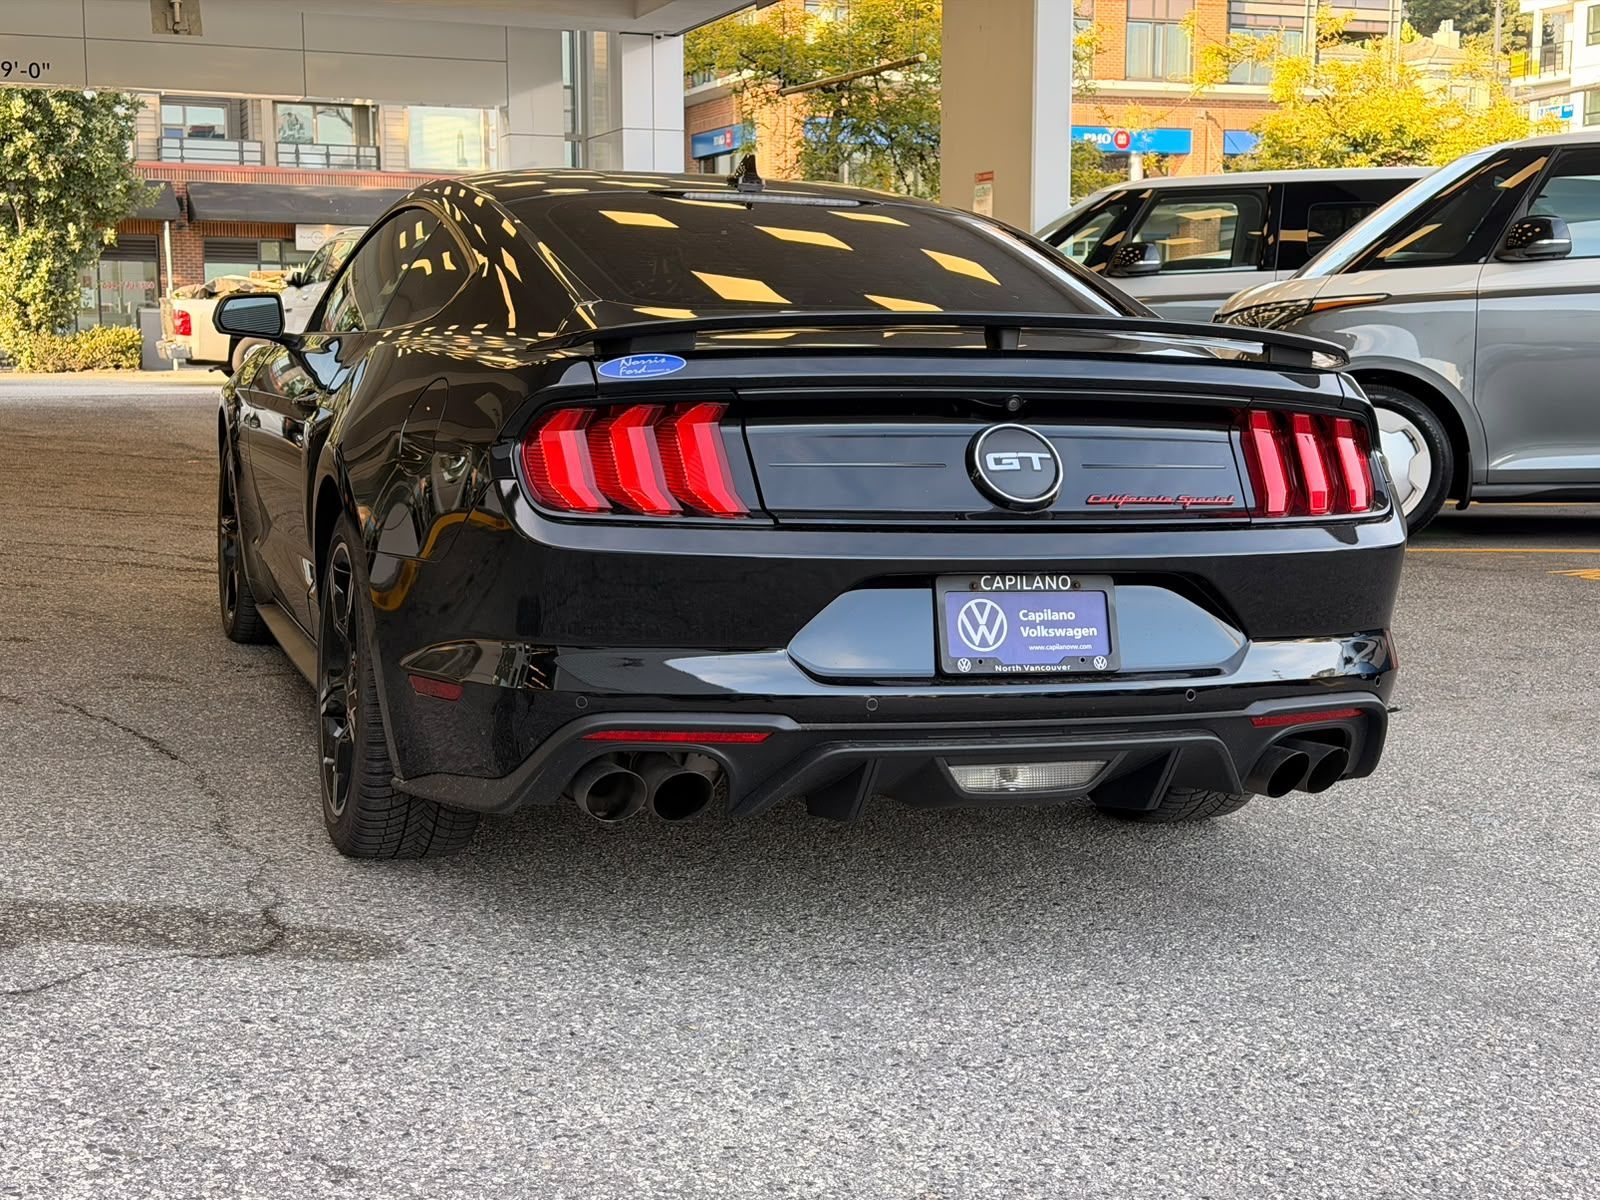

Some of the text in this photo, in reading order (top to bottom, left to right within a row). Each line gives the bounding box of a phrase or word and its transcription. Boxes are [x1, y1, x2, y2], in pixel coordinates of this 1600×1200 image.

[1, 61, 50, 79] 9'-0"
[620, 365, 648, 376] Ford
[986, 452, 1051, 471] GT
[1086, 494, 1235, 508] California Special
[980, 575, 1071, 590] CAPILANO
[1019, 609, 1076, 623] Capilano
[1020, 626, 1098, 639] Volkswagen
[1029, 643, 1093, 651] www.capilanovw.com
[995, 664, 1071, 672] North Vancouver
